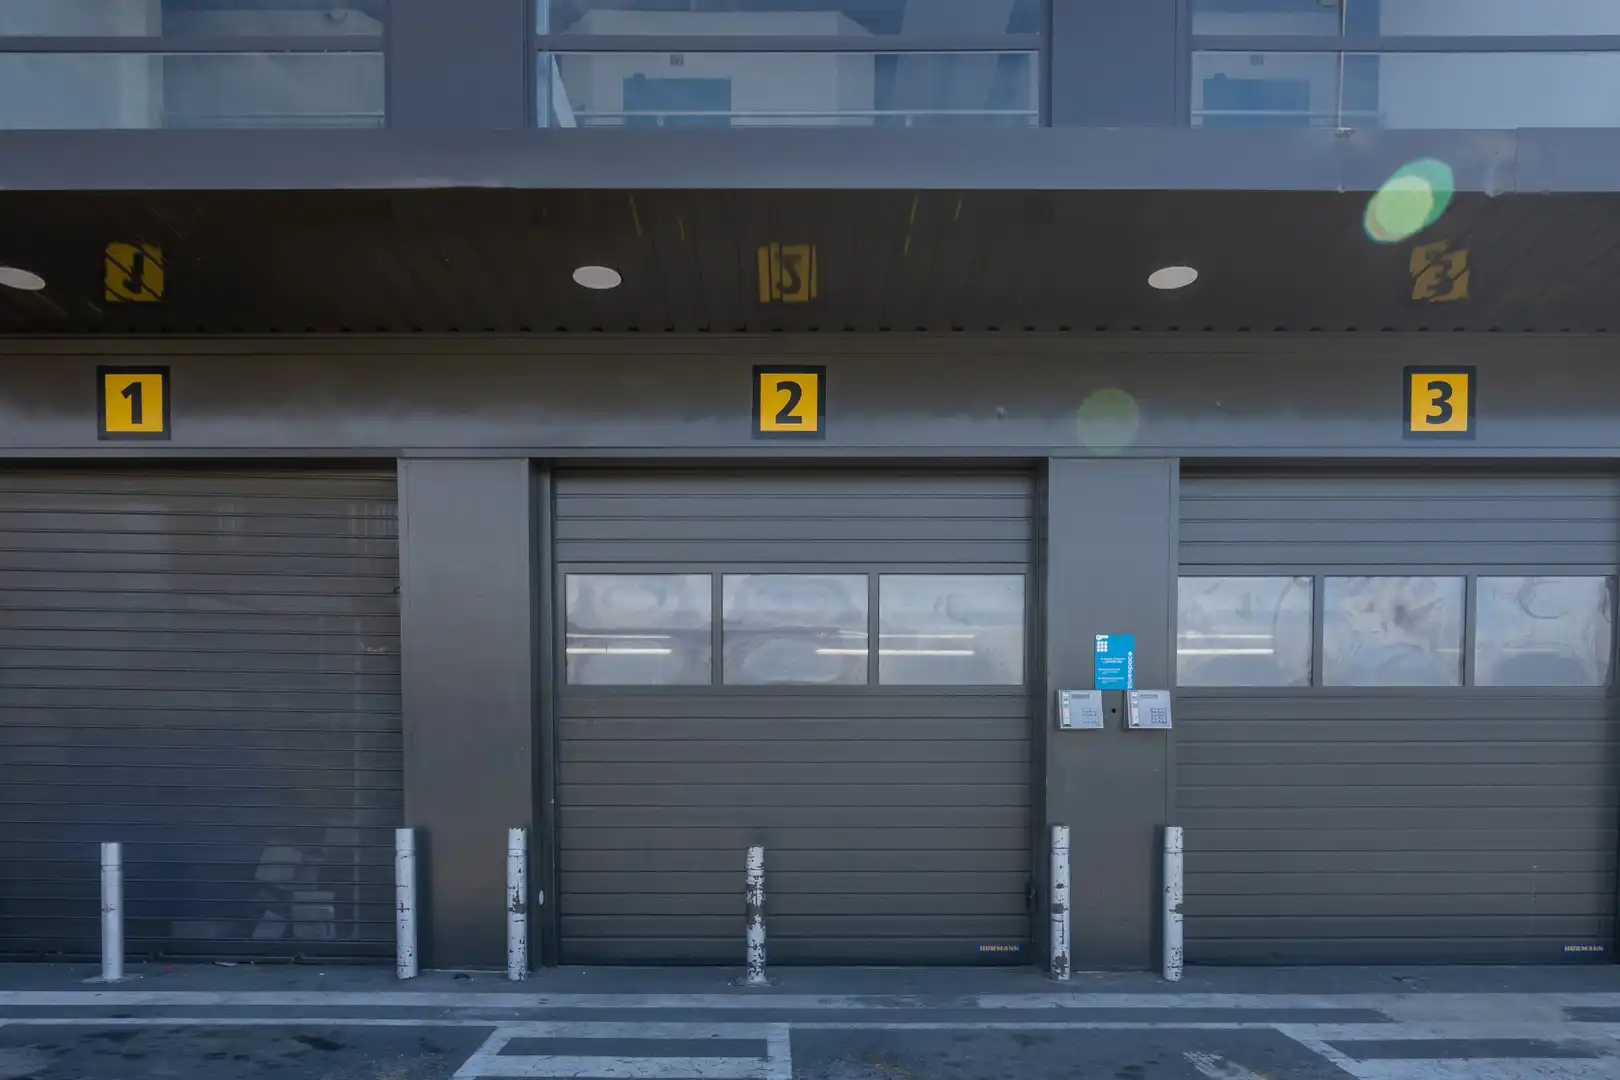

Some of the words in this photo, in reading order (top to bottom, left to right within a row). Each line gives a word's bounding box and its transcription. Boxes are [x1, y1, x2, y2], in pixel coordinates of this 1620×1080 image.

[121, 381, 142, 425] 1
[775, 380, 803, 425] 2
[1425, 380, 1453, 425] 3
